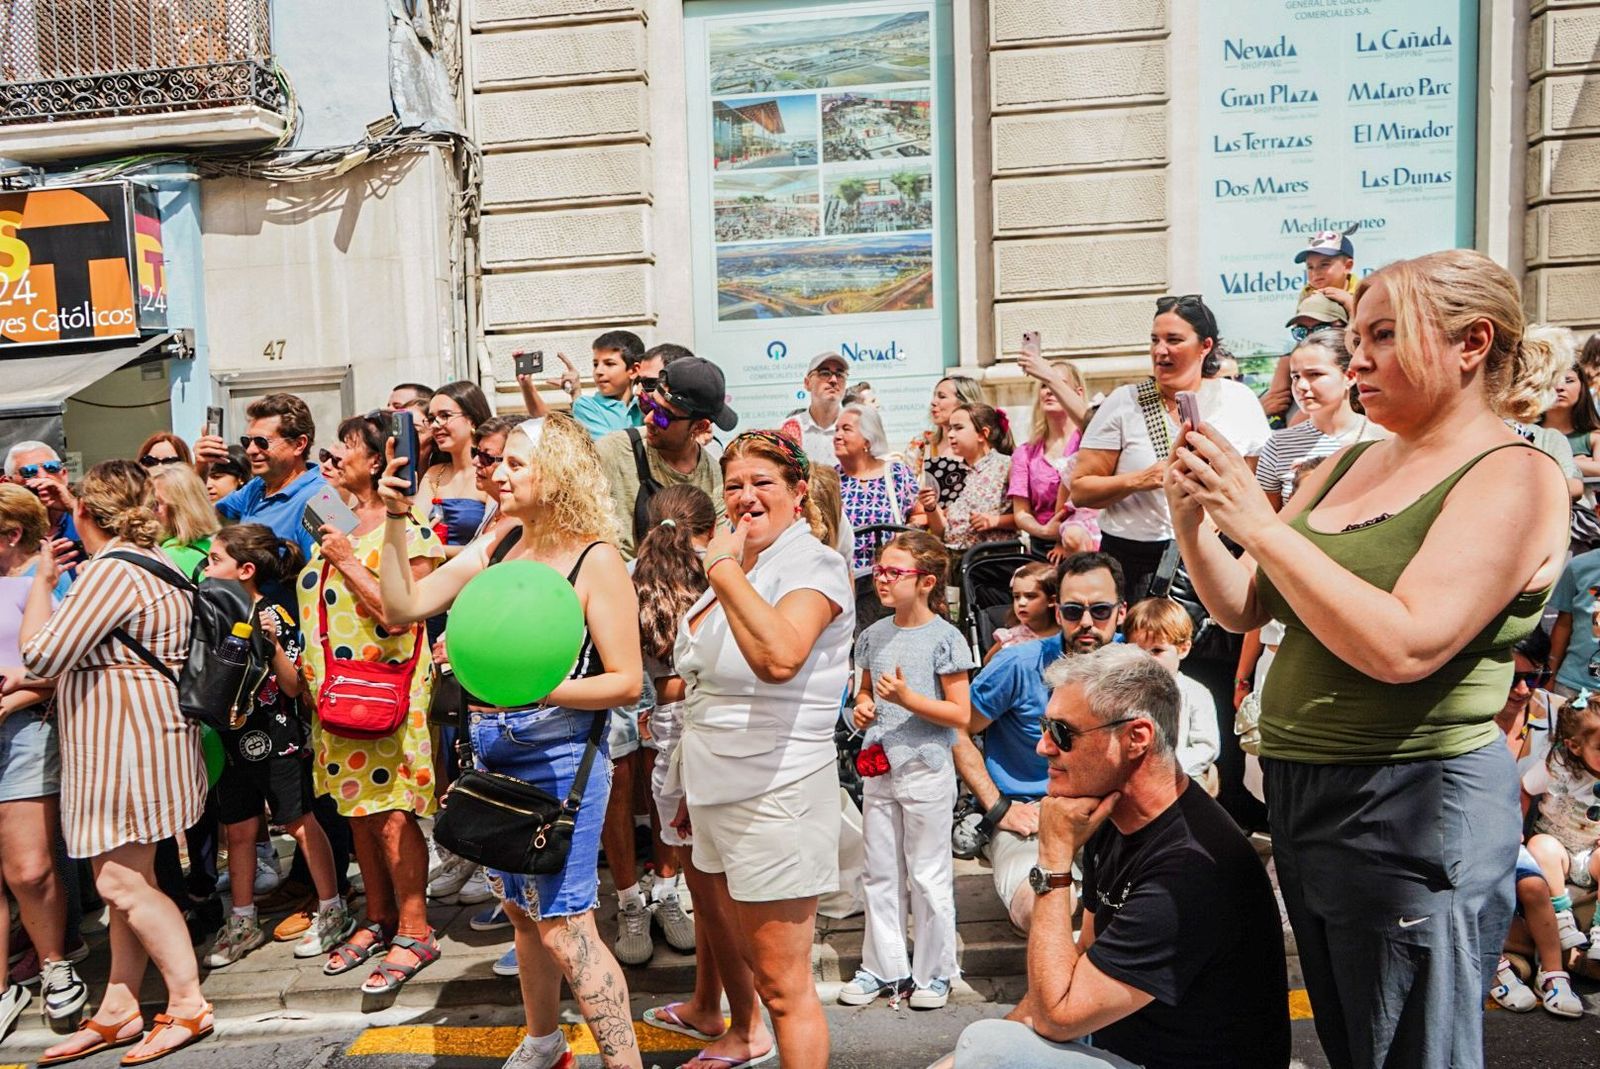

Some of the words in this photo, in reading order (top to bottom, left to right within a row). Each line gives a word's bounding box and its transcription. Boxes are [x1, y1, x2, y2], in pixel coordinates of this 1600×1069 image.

[1294, 9, 1355, 20] COMERCIALES
[1223, 35, 1297, 61] Nevada
[1240, 60, 1282, 70] SHOPPING
[1220, 88, 1265, 107] Gran
[1269, 84, 1319, 104] Plaza
[1418, 77, 1452, 97] Parc
[1213, 135, 1242, 152] Las
[1242, 131, 1313, 151] Terrazas
[1354, 124, 1372, 143] El
[1376, 120, 1454, 142] Mirador
[1215, 179, 1250, 198] Dos
[1252, 176, 1309, 195] Mares
[1361, 169, 1390, 188] Las
[1393, 167, 1452, 187] Dunas
[1219, 269, 1307, 295] Valdebe
[142, 285, 167, 313] 24
[32, 300, 133, 333] Católicos
[263, 340, 287, 361] 47
